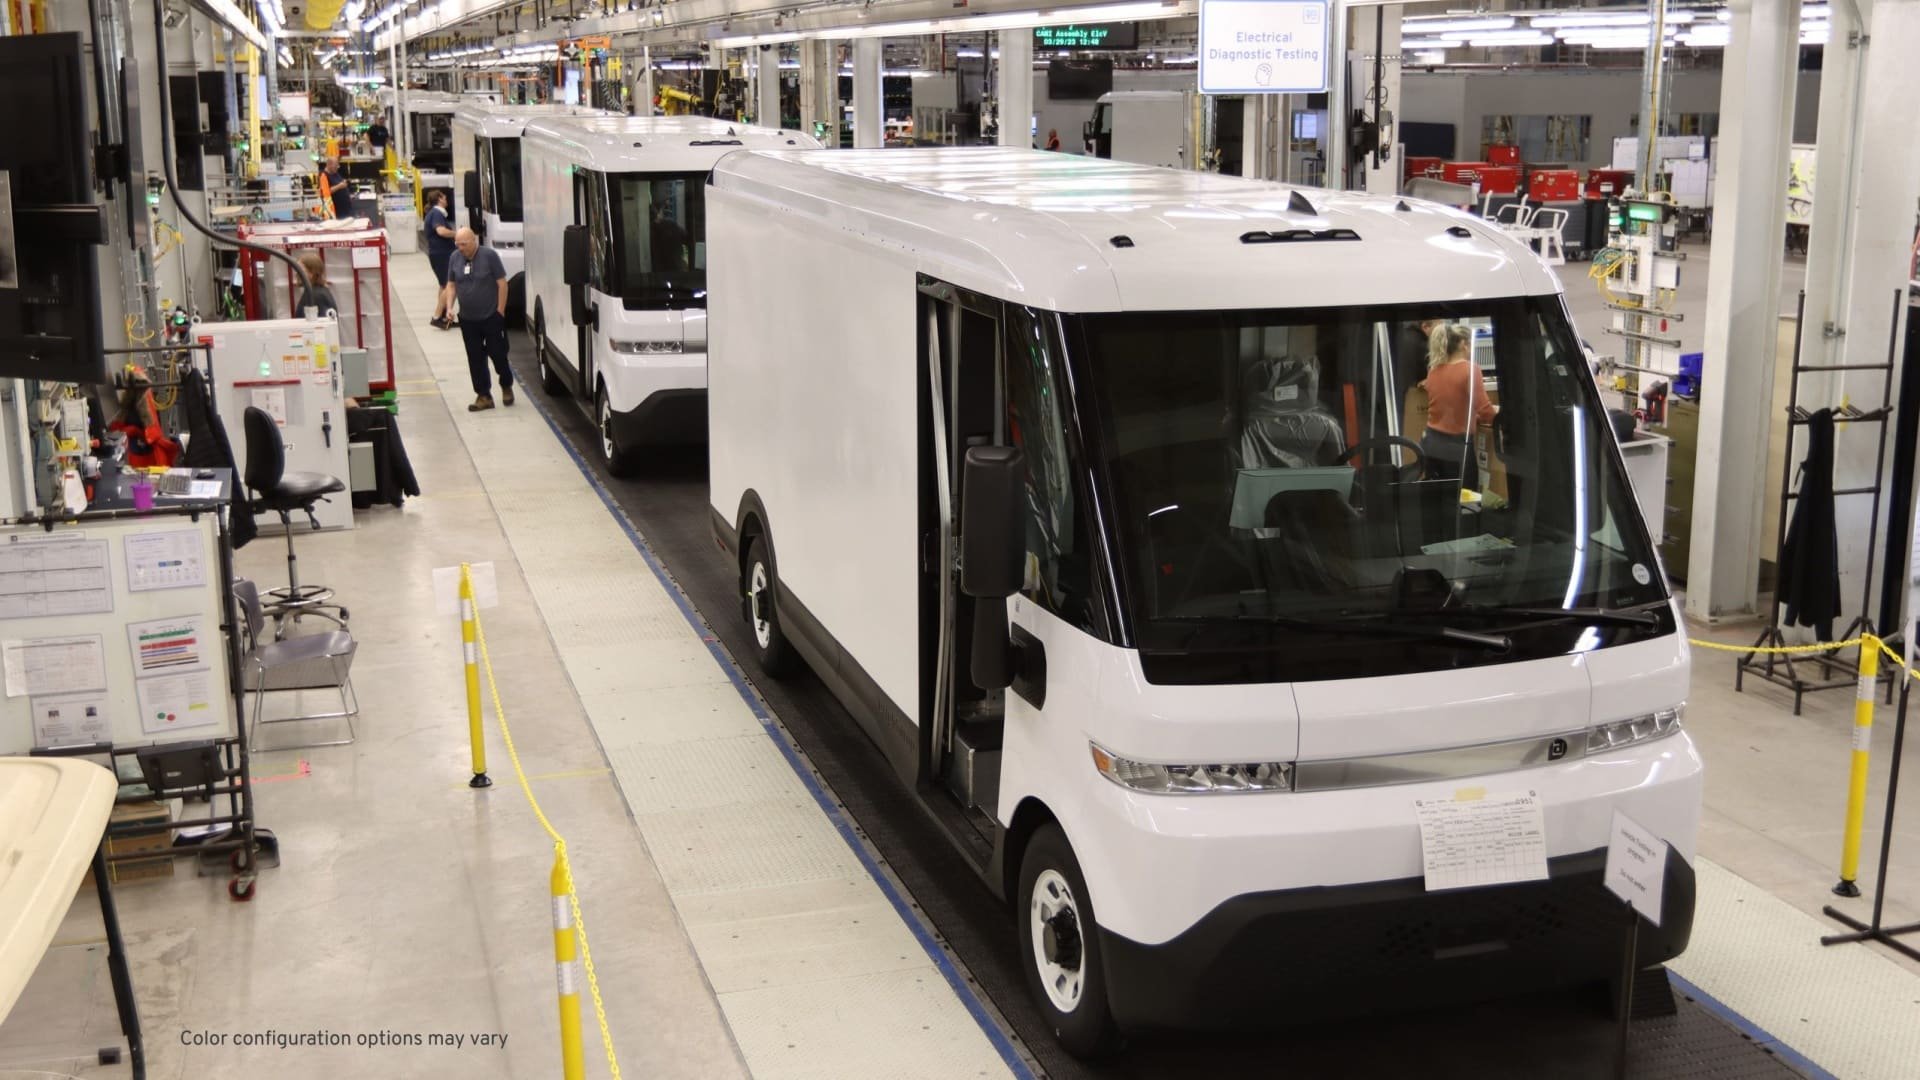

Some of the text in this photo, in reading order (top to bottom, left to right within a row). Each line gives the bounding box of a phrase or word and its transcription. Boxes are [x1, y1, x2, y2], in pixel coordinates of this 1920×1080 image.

[1236, 32, 1293, 43] Electrical
[1209, 48, 1319, 62] Diagnostic Testing
